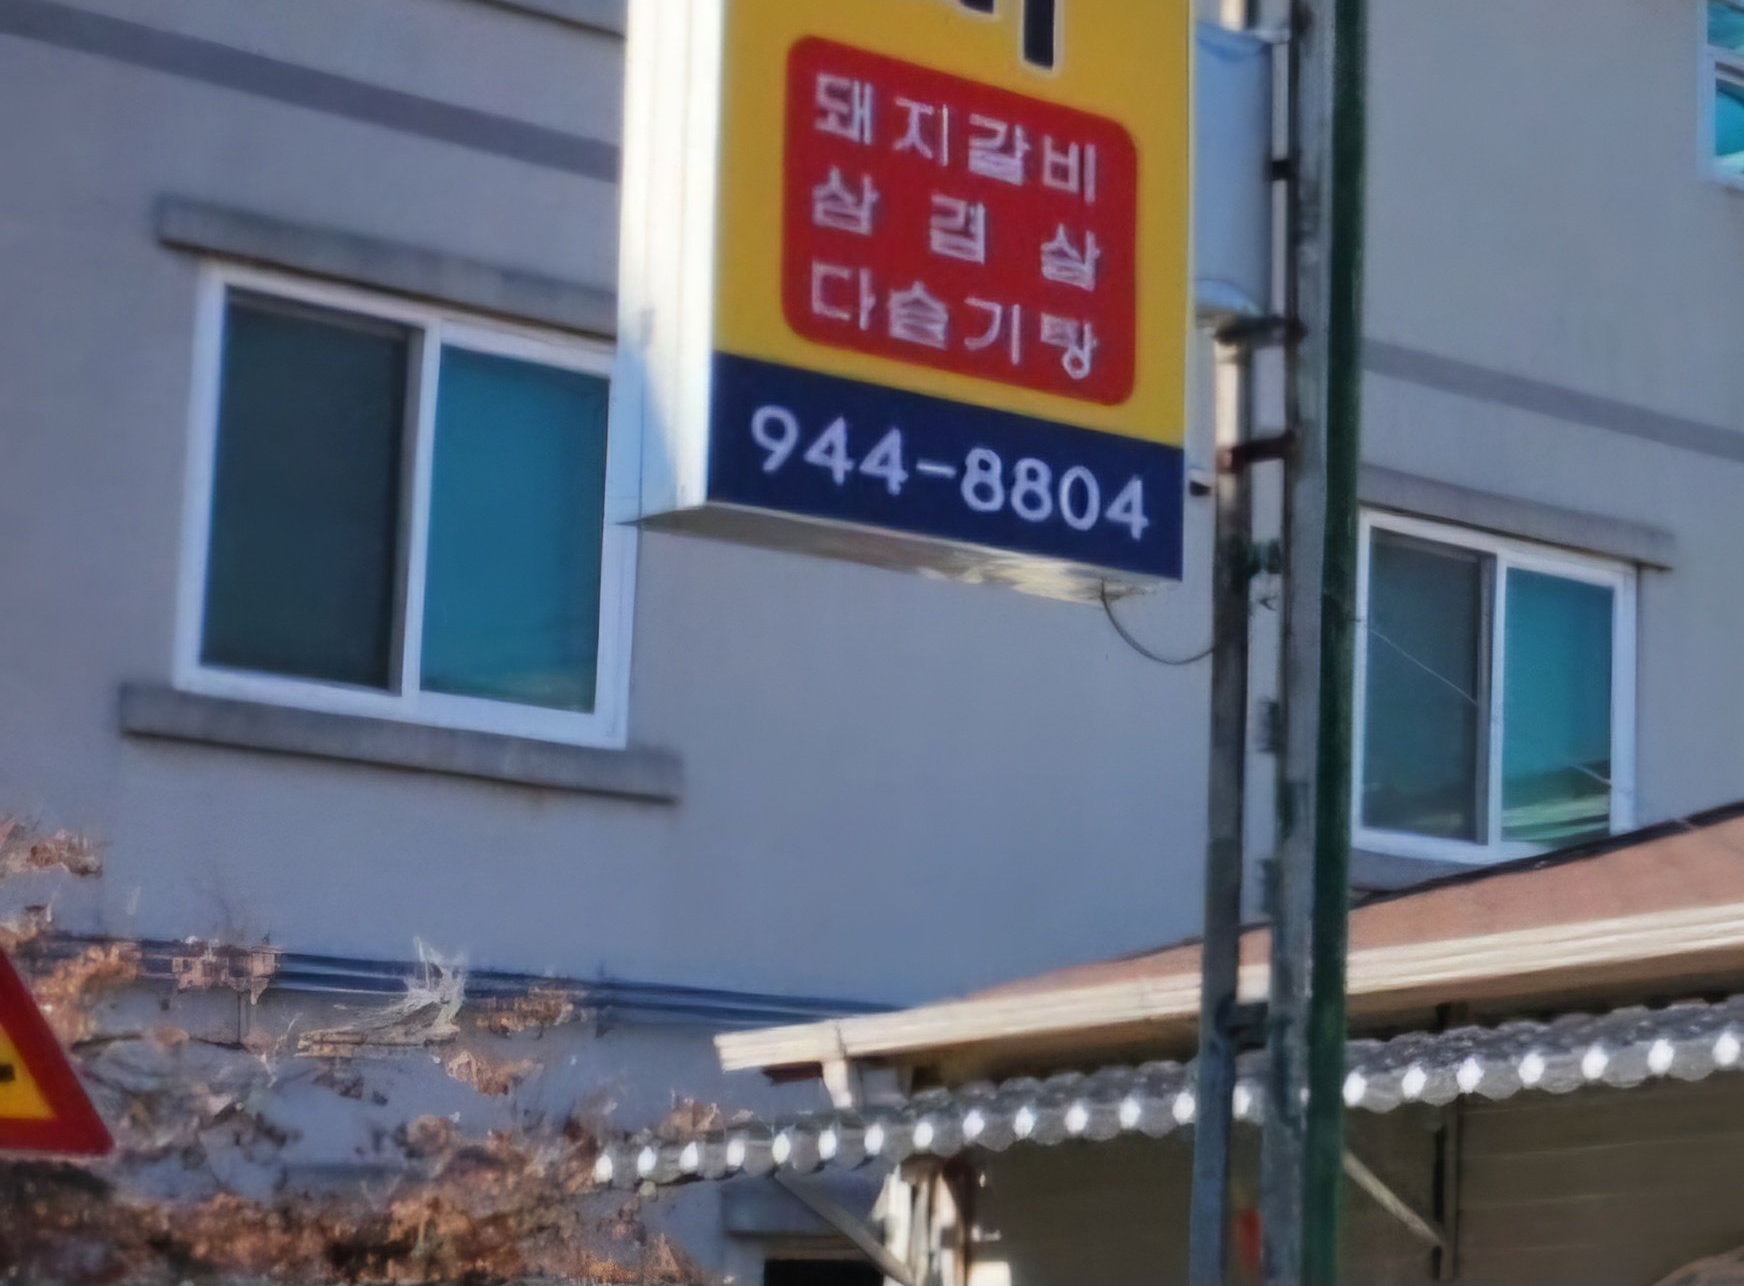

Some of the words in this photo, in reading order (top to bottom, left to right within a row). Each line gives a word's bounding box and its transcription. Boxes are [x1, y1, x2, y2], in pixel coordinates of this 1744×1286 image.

[812, 71, 1099, 206] 돼지갈비
[810, 259, 1100, 381] 다슬기탕
[750, 404, 1150, 541] 944-8804
